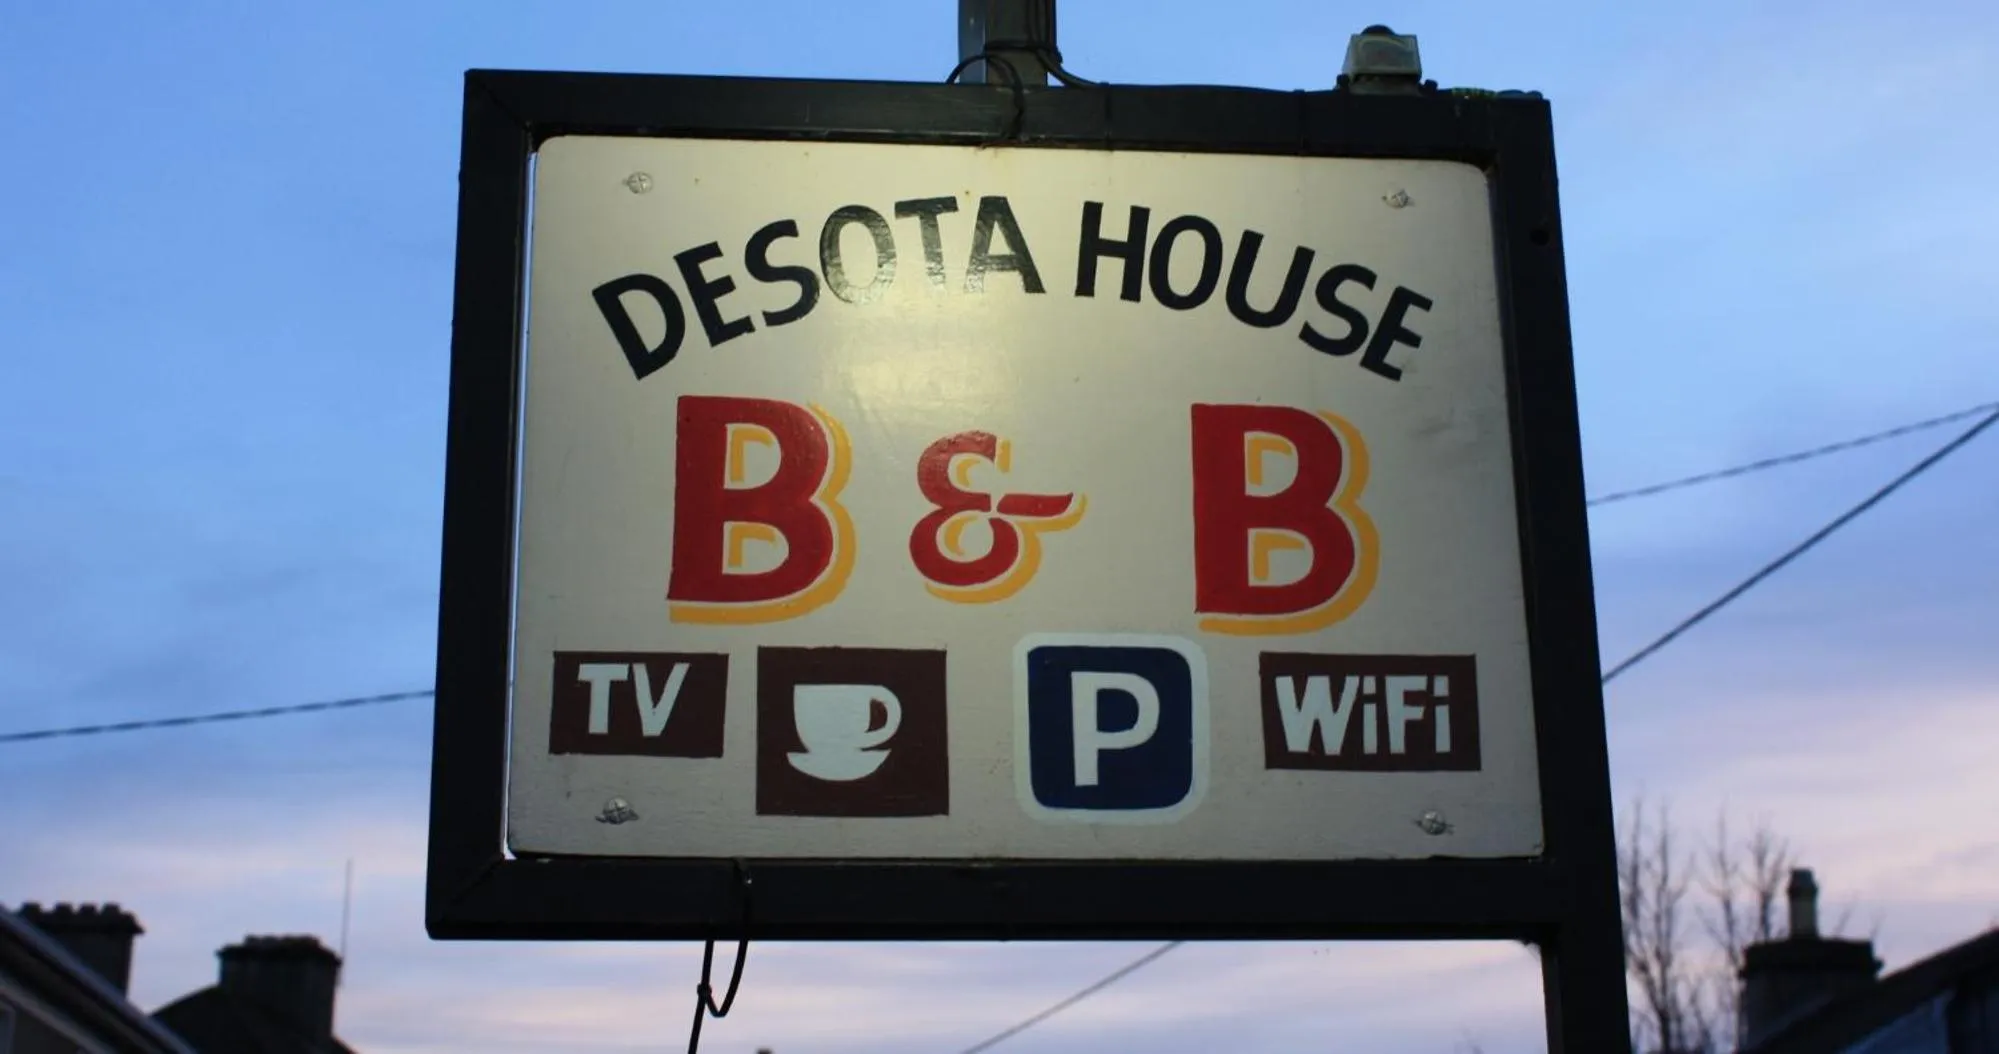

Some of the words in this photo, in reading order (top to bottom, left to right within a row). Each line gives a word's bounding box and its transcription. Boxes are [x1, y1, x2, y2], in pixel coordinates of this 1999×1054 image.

[592, 196, 1046, 380] DESOTA
[1075, 201, 1433, 382] HOUSE
[667, 395, 856, 623] B
[910, 430, 1087, 604] &
[1192, 403, 1381, 635] B
[577, 662, 691, 737] TV
[1070, 670, 1161, 787] P
[1274, 674, 1452, 756] WiFi
